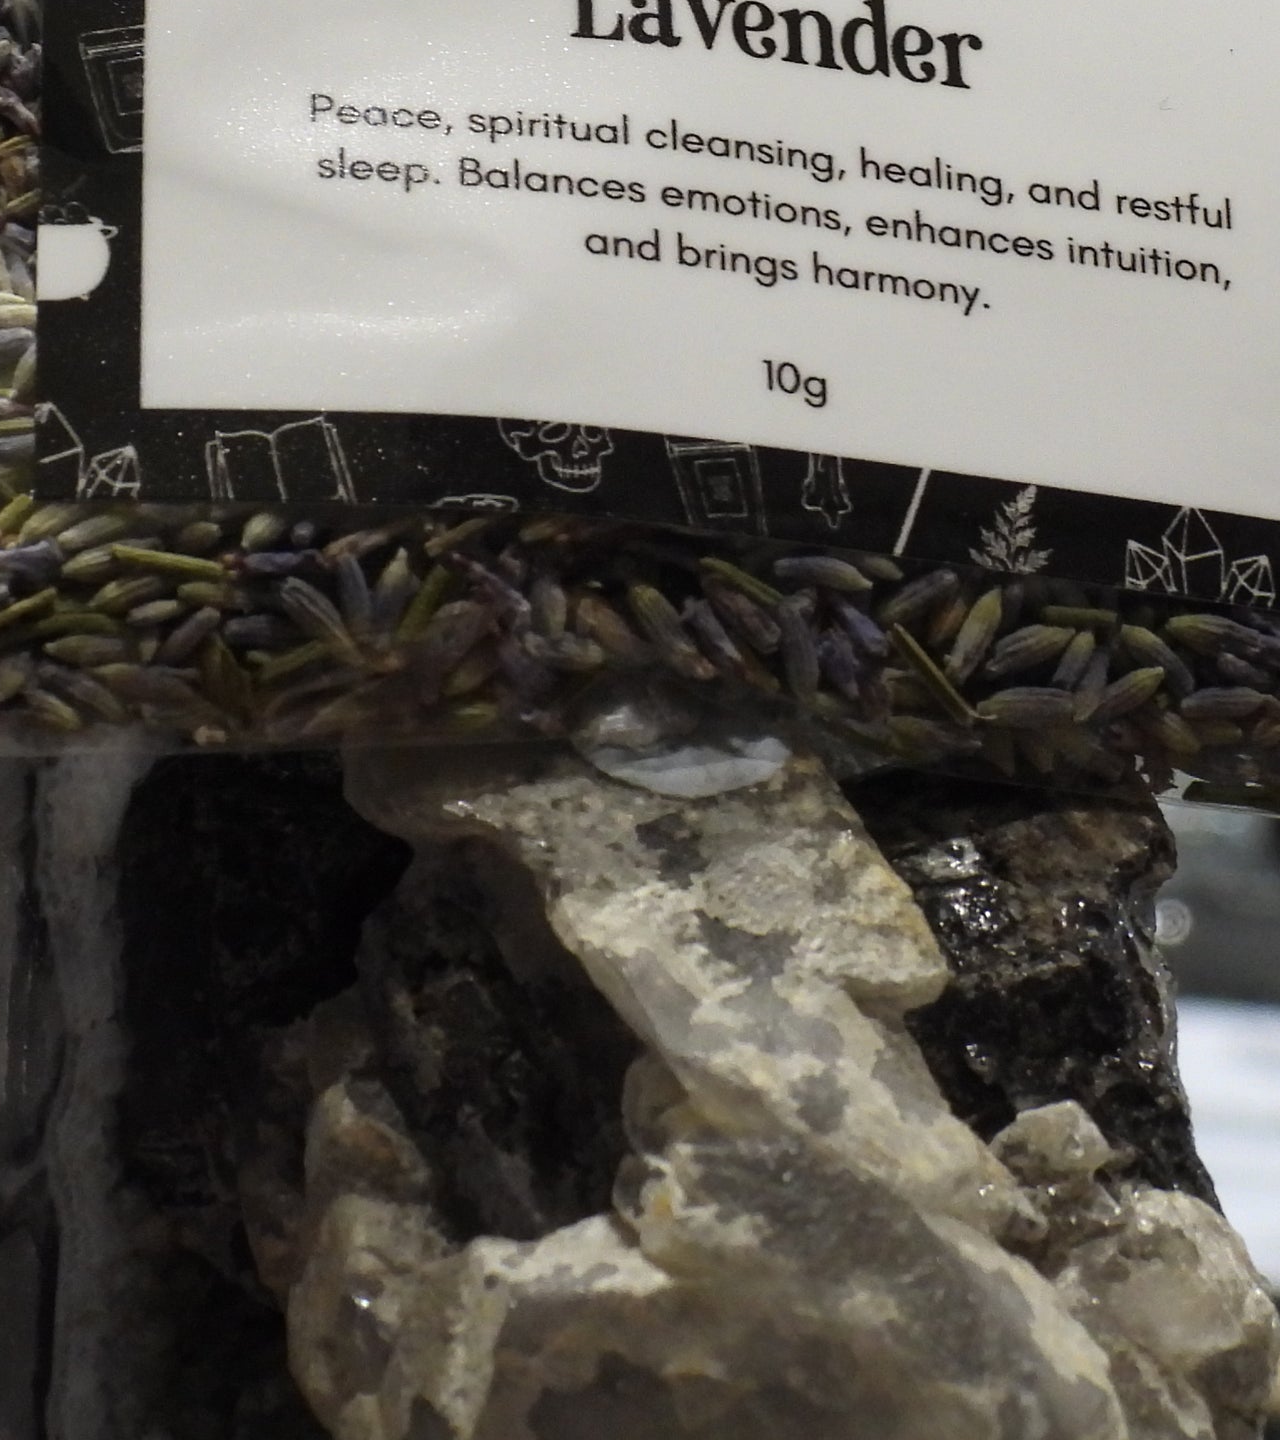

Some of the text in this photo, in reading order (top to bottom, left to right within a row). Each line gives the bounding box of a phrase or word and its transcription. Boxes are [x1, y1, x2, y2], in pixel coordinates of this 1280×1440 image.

[310, 94, 1232, 230] Peace, spiritual cleansing, healing, and restful
[318, 147, 1231, 291] sleep. Balances emotions, enhances intuition,
[584, 228, 990, 316] and brings harmony.
[762, 359, 828, 408] 10g
